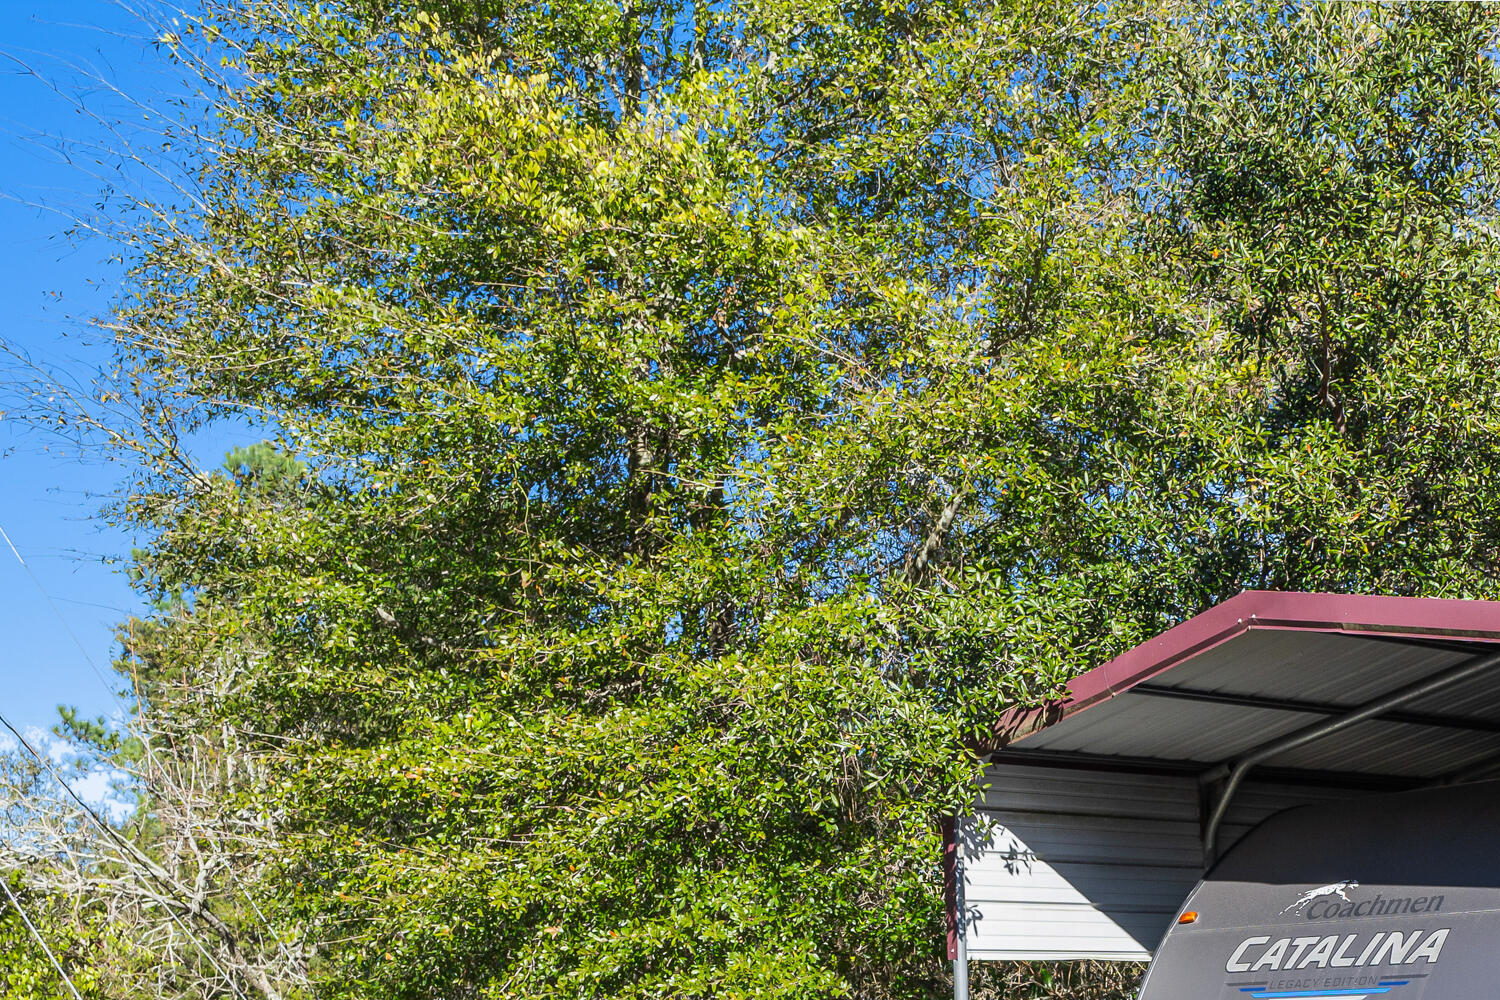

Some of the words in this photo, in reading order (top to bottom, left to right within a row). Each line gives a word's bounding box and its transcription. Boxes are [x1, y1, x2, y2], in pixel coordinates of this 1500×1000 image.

[1306, 894, 1444, 920] Coachmen
[1225, 927, 1452, 973] CATALINA
[1269, 978, 1320, 990] LEGACY
[1323, 975, 1377, 988] EDITION
